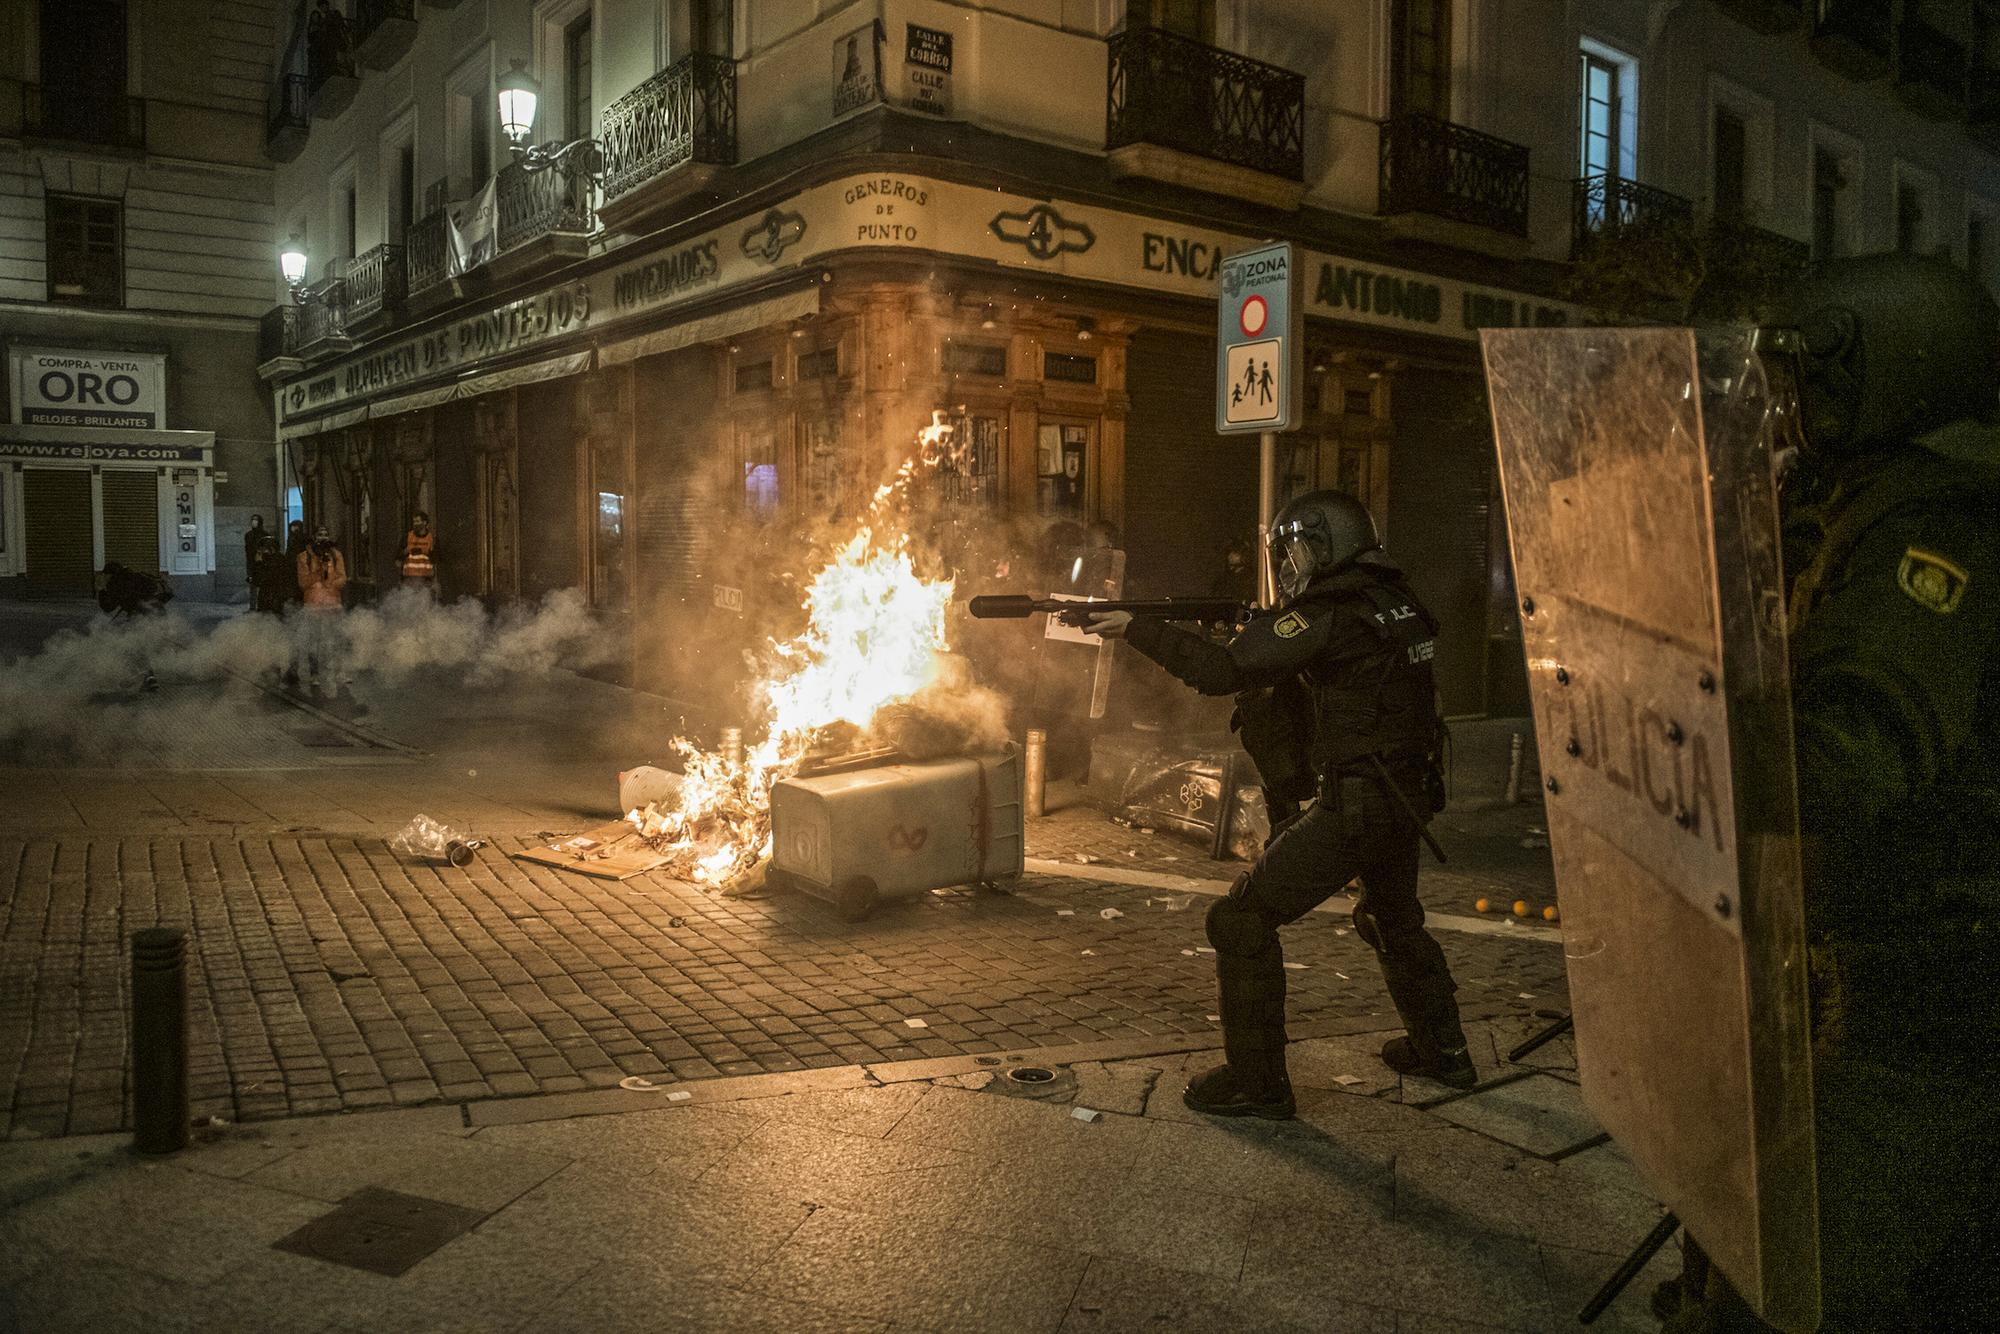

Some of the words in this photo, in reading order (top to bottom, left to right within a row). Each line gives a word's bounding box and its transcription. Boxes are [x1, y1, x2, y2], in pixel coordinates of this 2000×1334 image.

[915, 29, 944, 47] CALLE
[910, 47, 950, 68] CORREO
[844, 179, 928, 206] GENEROS
[876, 204, 894, 216] DE
[857, 224, 918, 241] PUNTO
[614, 238, 719, 309] NOVEDADES
[1246, 255, 1287, 278] ZONA
[1246, 272, 1287, 288] PEATONAL
[1315, 261, 1441, 325] ANTONIO
[458, 282, 591, 359] PONTEJOS
[38, 357, 92, 370] COMPRA
[100, 360, 139, 372] VENTA
[38, 371, 140, 406] ORO
[32, 414, 77, 425] RELOJES
[84, 416, 148, 428] BRILLANTES
[0, 444, 180, 459] www.rejoya.com
